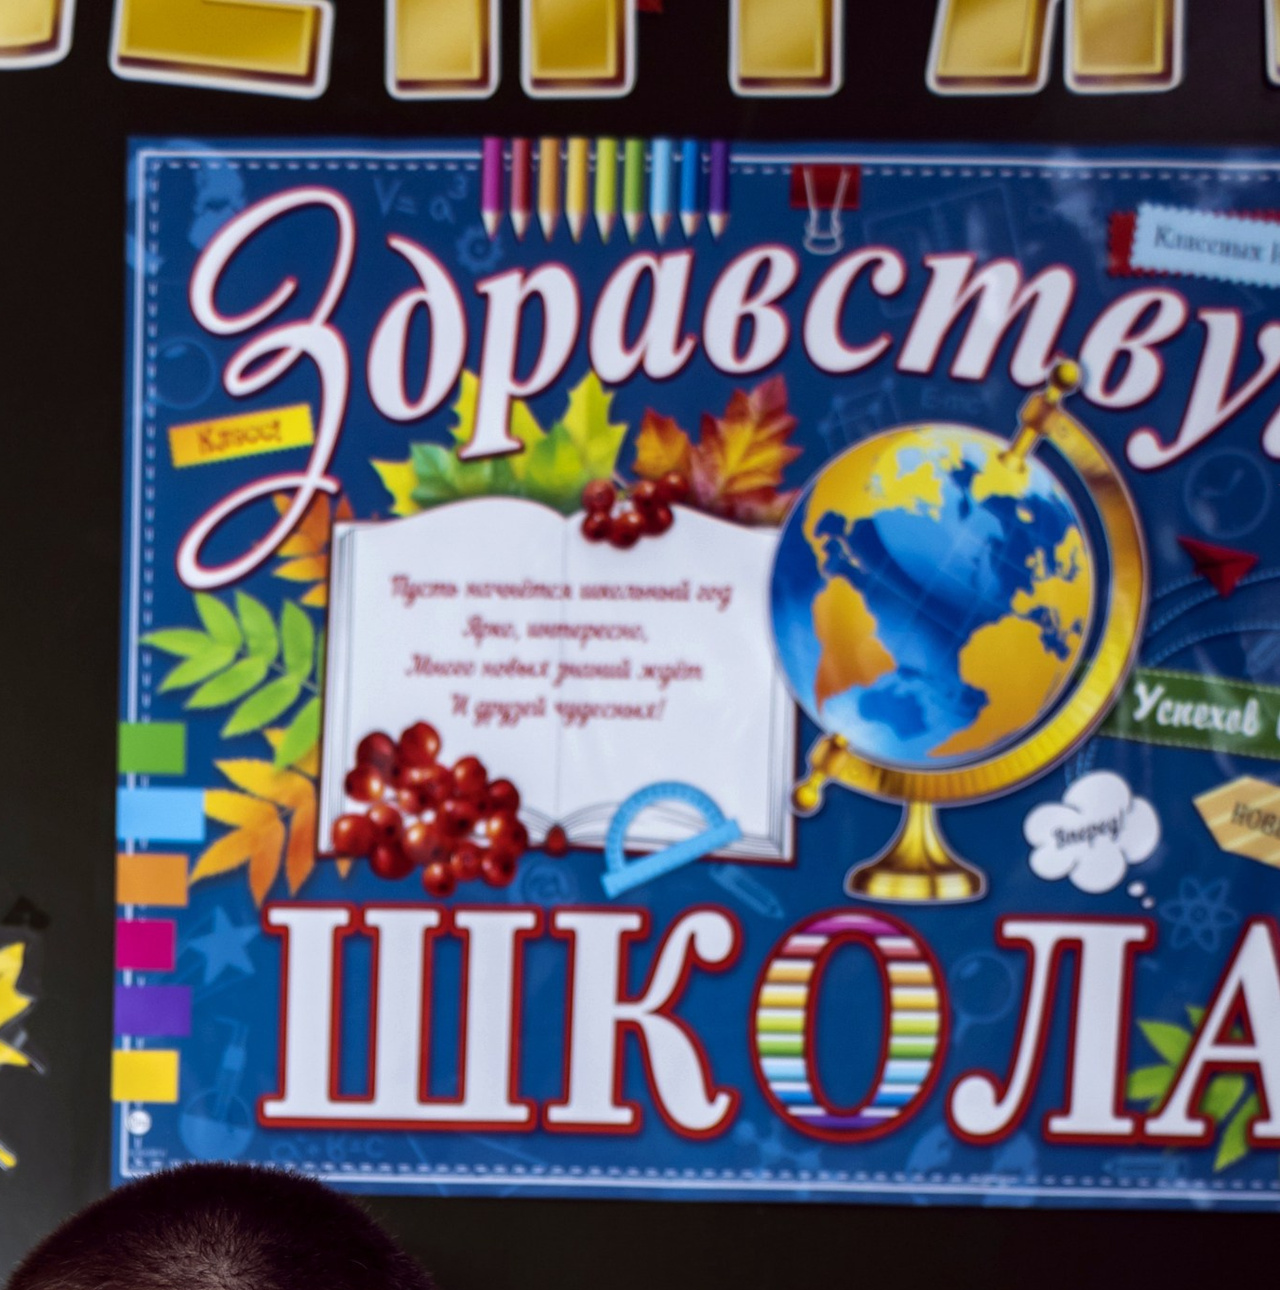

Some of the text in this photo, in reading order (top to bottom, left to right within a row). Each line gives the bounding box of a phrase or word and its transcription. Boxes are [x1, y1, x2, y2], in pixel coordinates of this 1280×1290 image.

[175, 184, 1280, 590] Здравству
[391, 574, 458, 609] Пусть
[580, 579, 690, 601] школьный
[696, 584, 733, 613] год
[406, 654, 473, 678] Много
[481, 657, 549, 678] новых
[552, 658, 630, 688] знаний
[473, 697, 545, 728] друзей
[1132, 681, 1261, 737] Успехов
[257, 902, 1280, 1150] ШКОЛА
